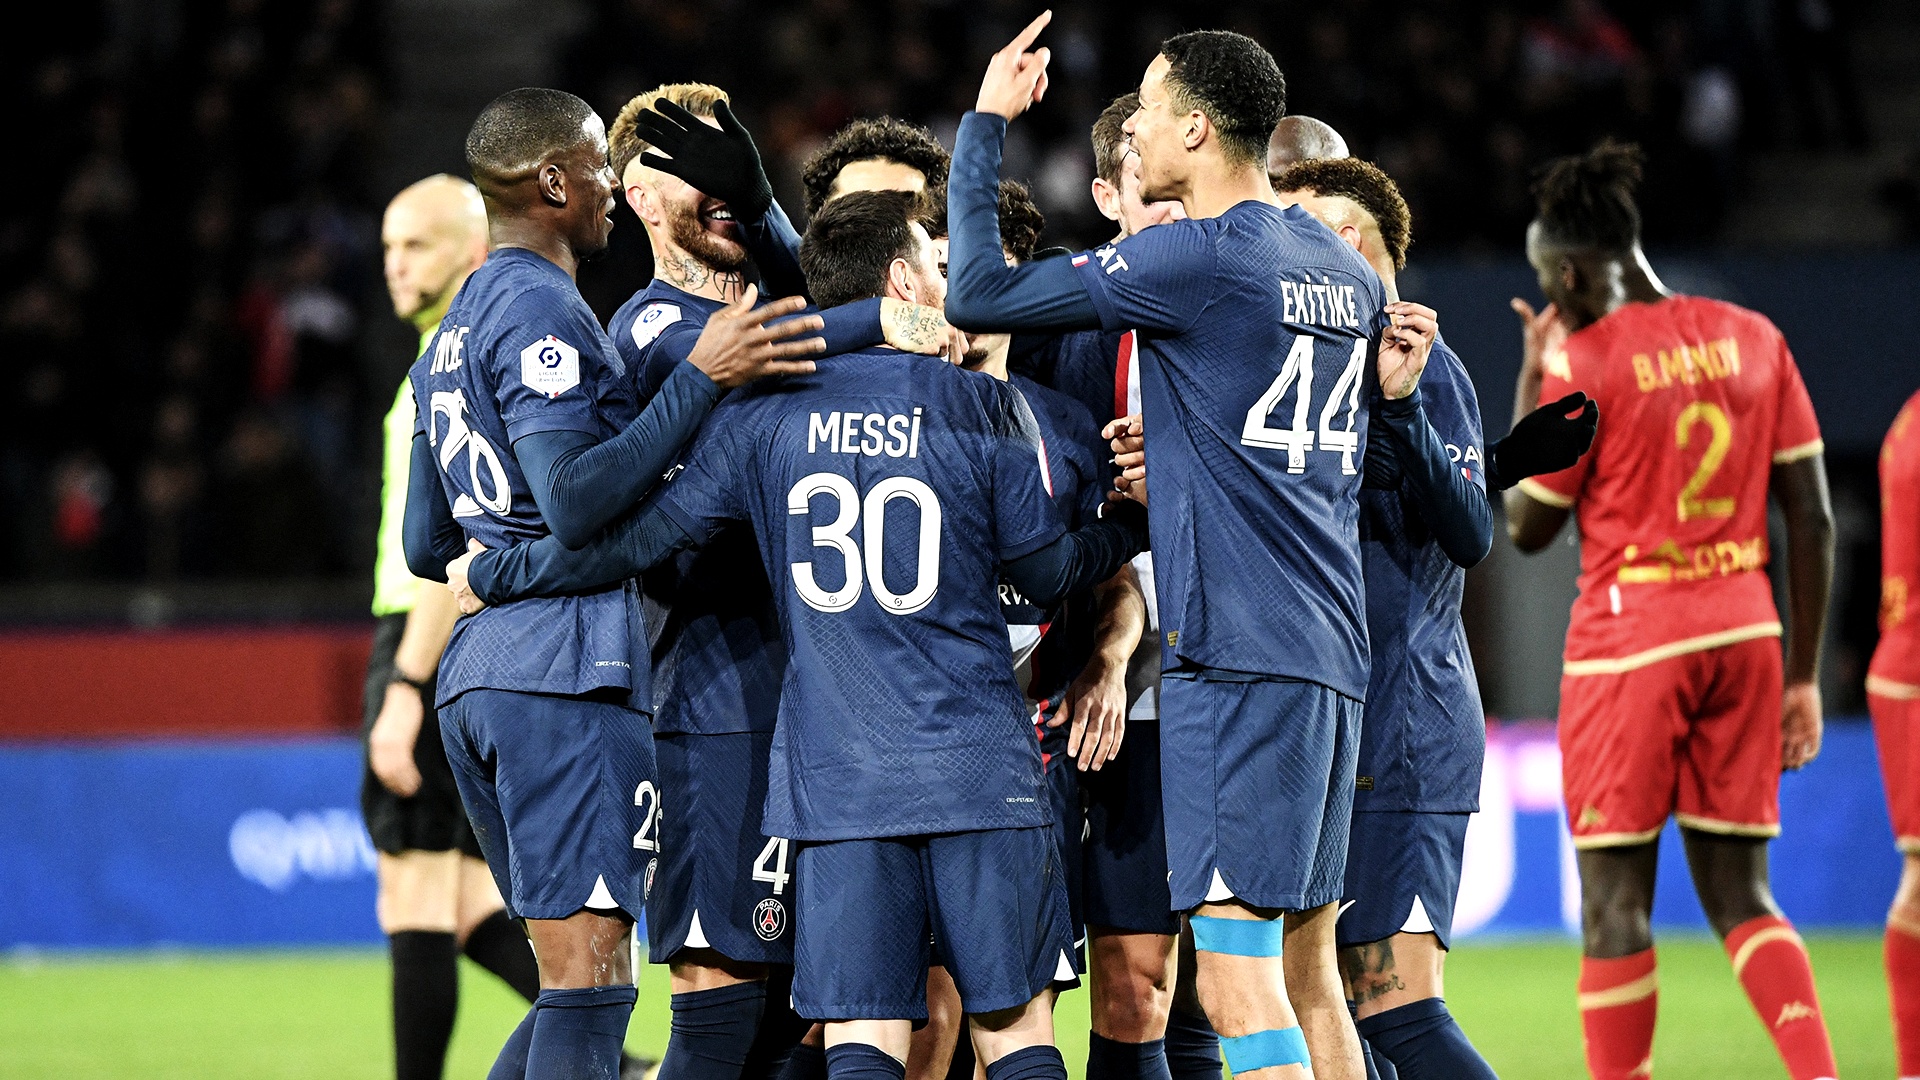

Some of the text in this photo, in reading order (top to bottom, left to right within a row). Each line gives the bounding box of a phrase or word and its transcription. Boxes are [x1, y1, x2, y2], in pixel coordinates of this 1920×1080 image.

[808, 407, 922, 458] MESSI
[1240, 334, 1368, 476] 44
[1676, 401, 1735, 522] 2
[788, 472, 942, 615] 30
[752, 836, 790, 895] 4
[759, 900, 783, 912] PARIS
